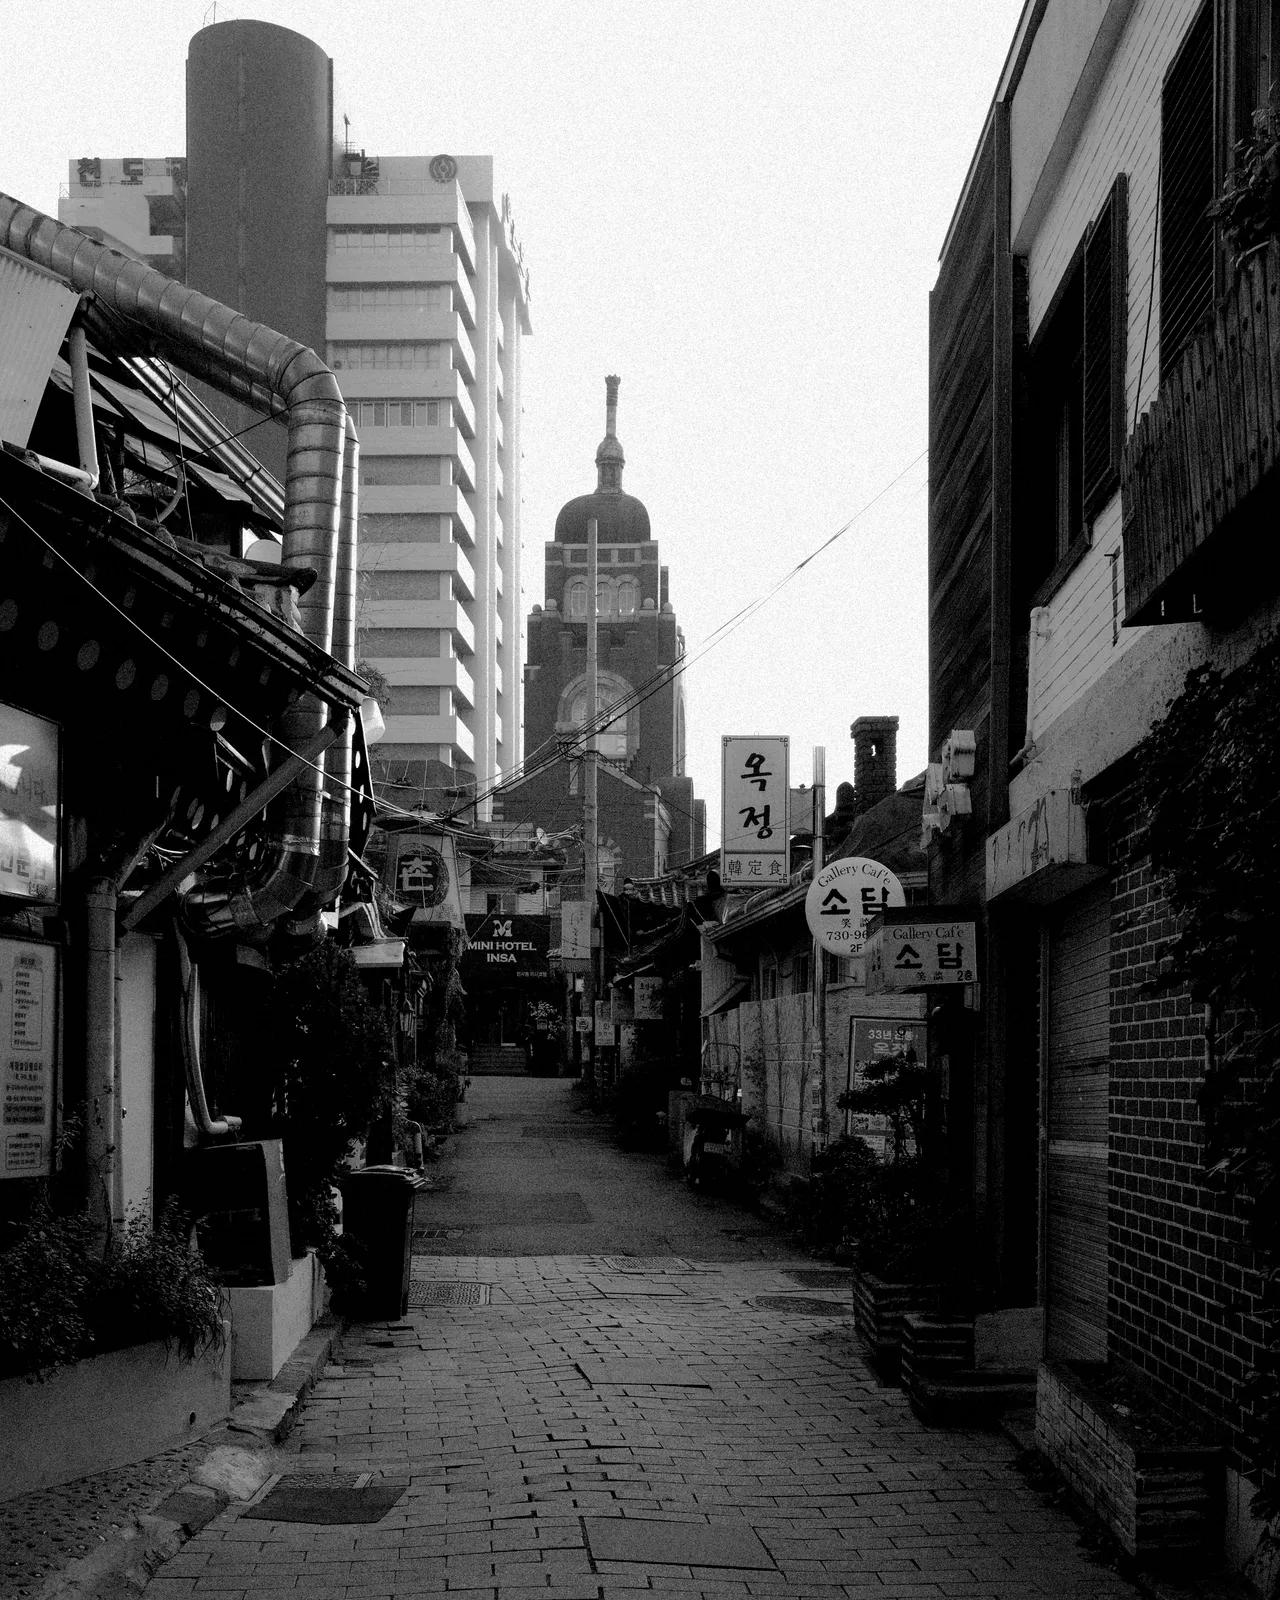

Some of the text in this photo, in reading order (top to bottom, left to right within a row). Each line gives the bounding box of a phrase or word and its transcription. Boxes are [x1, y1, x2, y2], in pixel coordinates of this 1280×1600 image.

[739, 753, 773, 839] 옥정
[728, 860, 782, 876] 韓定食
[818, 864, 859, 888] Gallery
[820, 886, 890, 915] 소담
[826, 931, 868, 941] 730-96
[893, 926, 933, 941] Gallery
[467, 941, 537, 951] MINI HOTEL
[850, 944, 863, 953] 2F
[486, 953, 517, 963] INSA
[895, 942, 963, 969] 소담
[868, 1029, 892, 1040] 33년
